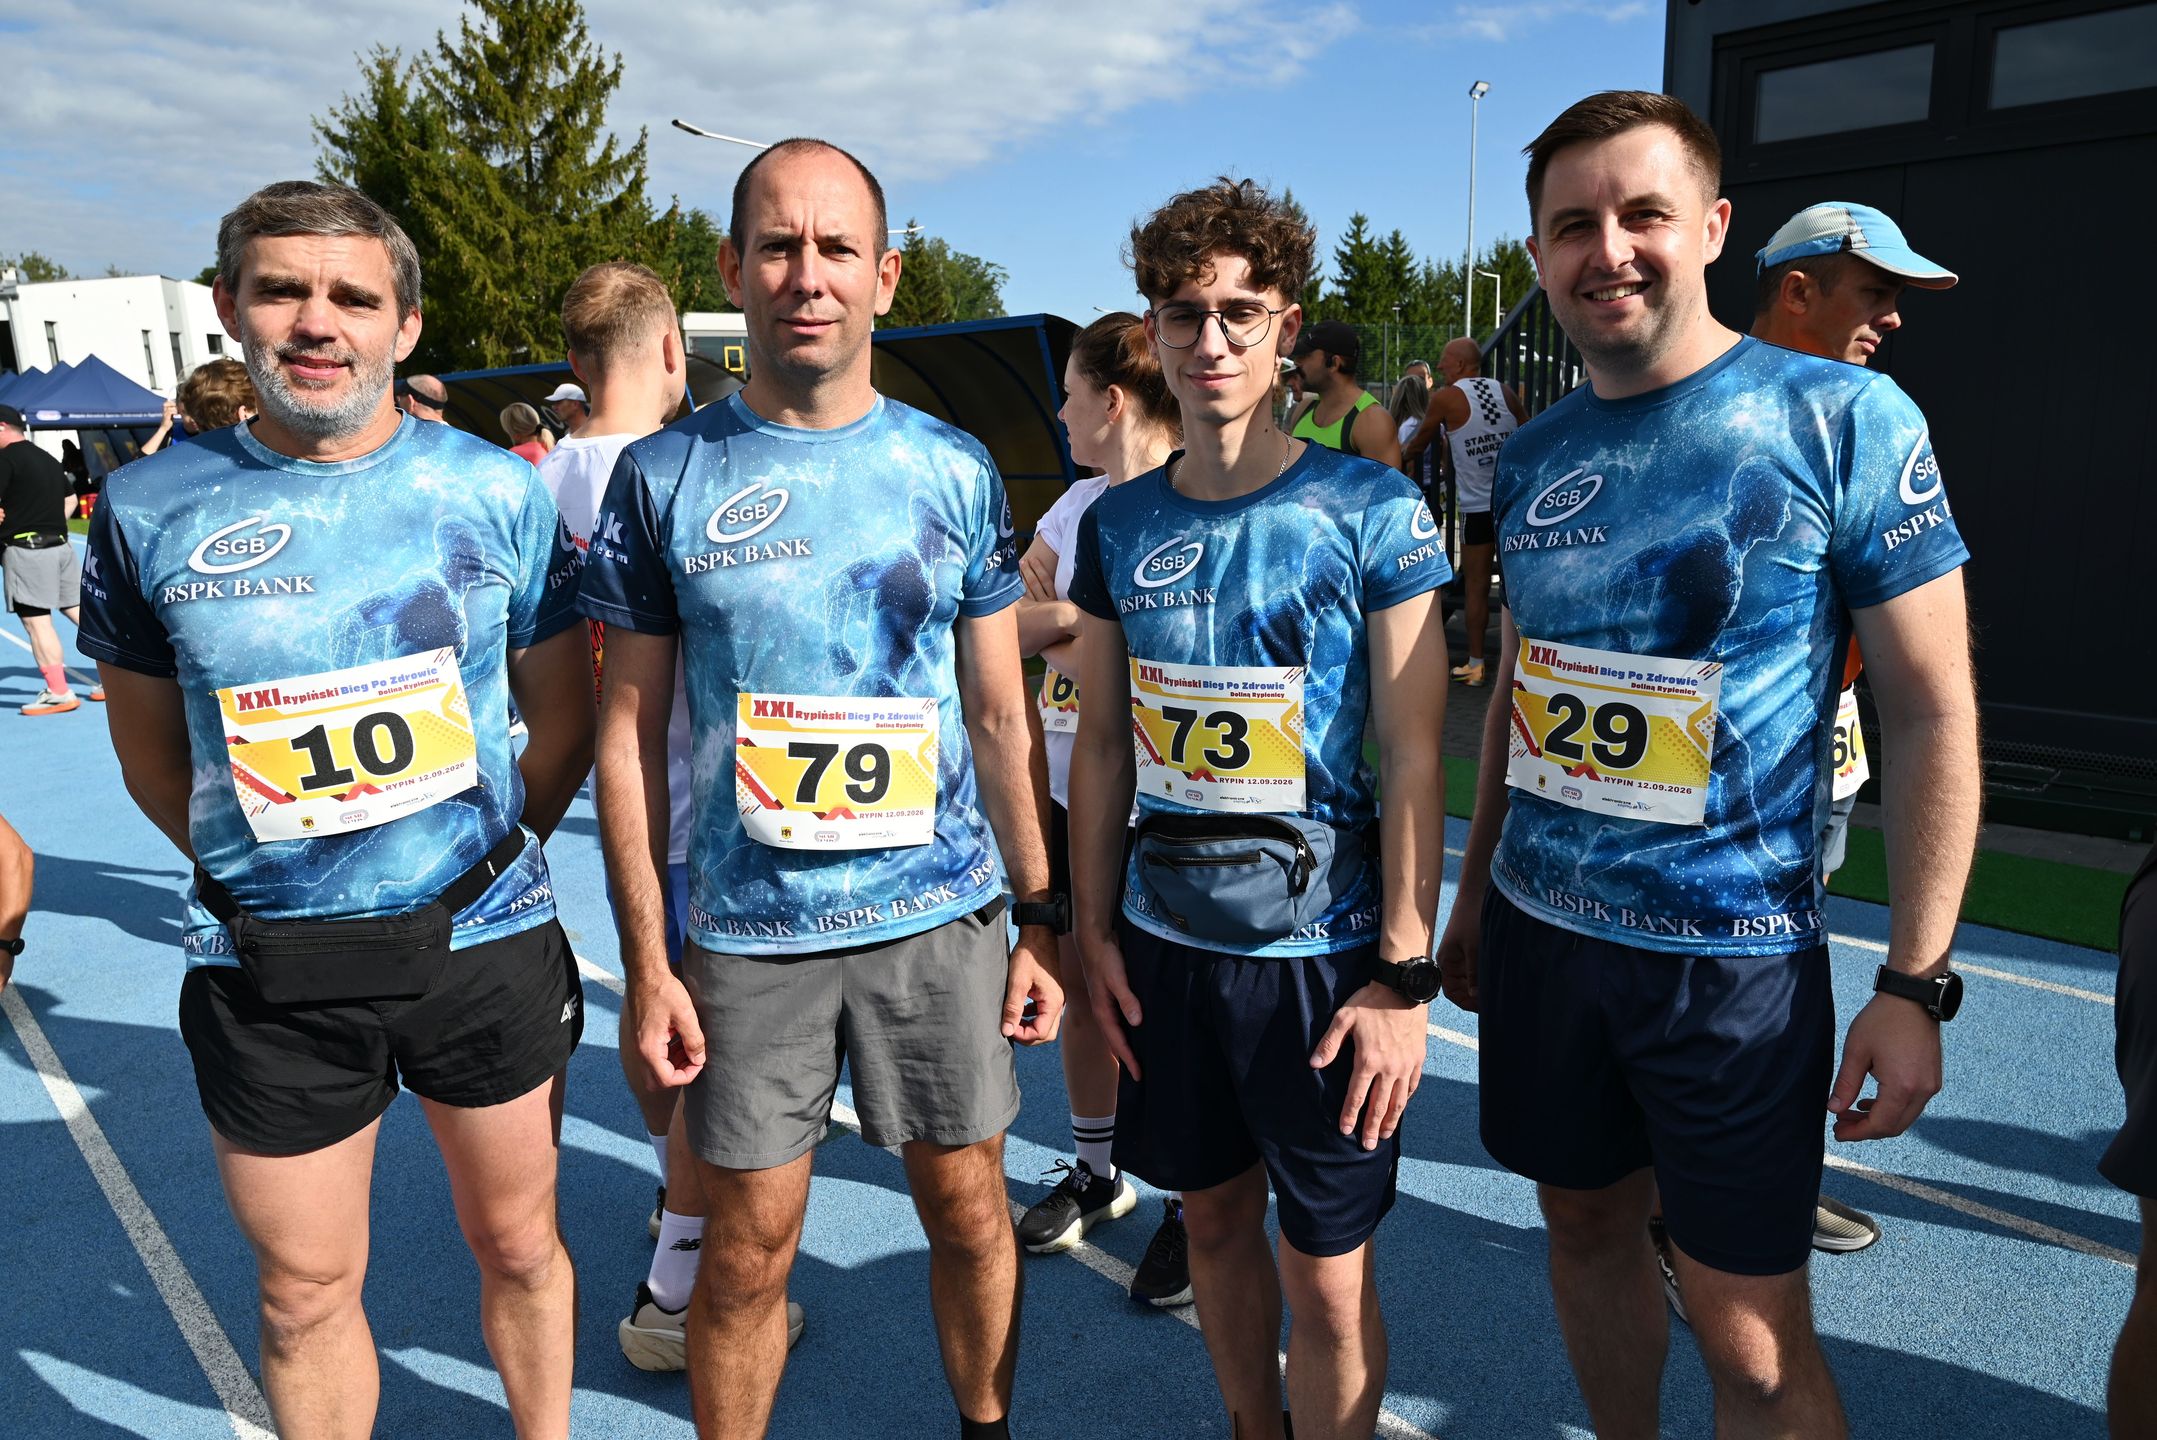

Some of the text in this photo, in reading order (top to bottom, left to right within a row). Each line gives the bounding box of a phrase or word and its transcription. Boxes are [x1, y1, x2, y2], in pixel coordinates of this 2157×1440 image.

[1464, 433, 1497, 447] START
[1544, 489, 1581, 508] SGB
[726, 503, 769, 524] SGB
[1504, 526, 1610, 552] BSPK BANK
[1882, 505, 1944, 551] BSPK
[213, 537, 266, 556] SGB
[684, 538, 813, 574] BSPK BANK
[1397, 542, 1435, 571] BSPK
[1150, 555, 1186, 572] SGB
[164, 576, 317, 604] BSPK BANK
[1119, 587, 1216, 614] BSPK BANK
[1139, 665, 1285, 690] XXI Rypiński Bieg Po Zdrowie
[1529, 645, 1698, 687] XXI Rypiński Bieg Po Zdrowie
[236, 666, 438, 711] XXI Rypiński Bieg Po Zdrowie
[753, 700, 794, 718] XXI
[795, 710, 846, 722] Rypiński
[848, 713, 870, 721] Bieg
[887, 713, 924, 721] Zdrowie
[1162, 705, 1251, 770] 73
[1544, 693, 1648, 769] 29
[291, 711, 414, 792] 10
[385, 762, 466, 791] RYPIN 12.09.2026
[788, 742, 890, 804] 79
[1219, 777, 1244, 785] RYPIN
[1604, 777, 1692, 795] RYPIN 12.09.2026
[885, 810, 924, 818] 12.09.2026
[509, 882, 552, 915] BSPK
[816, 882, 959, 933] BSPK BANK
[689, 903, 794, 938] BSPK BANK
[1548, 888, 1703, 938] BSPK BANK
[1731, 911, 1803, 938] BSPK
